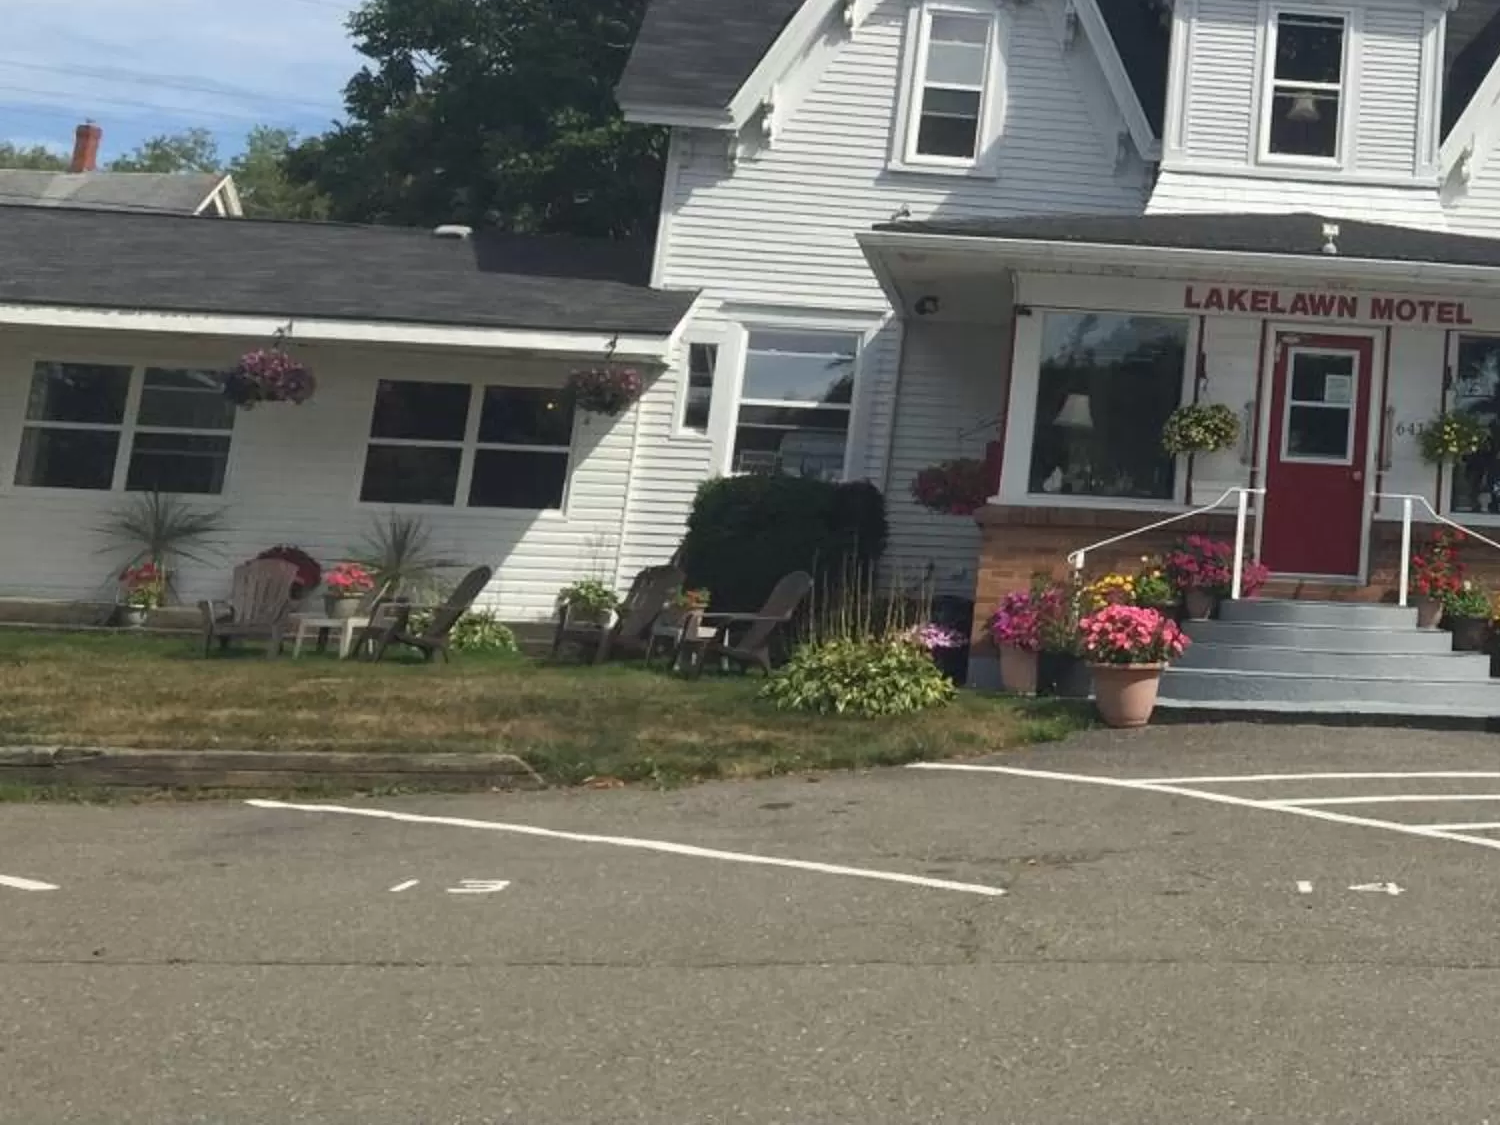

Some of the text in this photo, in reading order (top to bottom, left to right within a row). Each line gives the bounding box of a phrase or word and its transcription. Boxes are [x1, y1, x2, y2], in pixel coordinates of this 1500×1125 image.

[1184, 285, 1473, 324] LAKELAWN MOTEL
[389, 879, 511, 893] 13
[1296, 880, 1406, 895] 14
